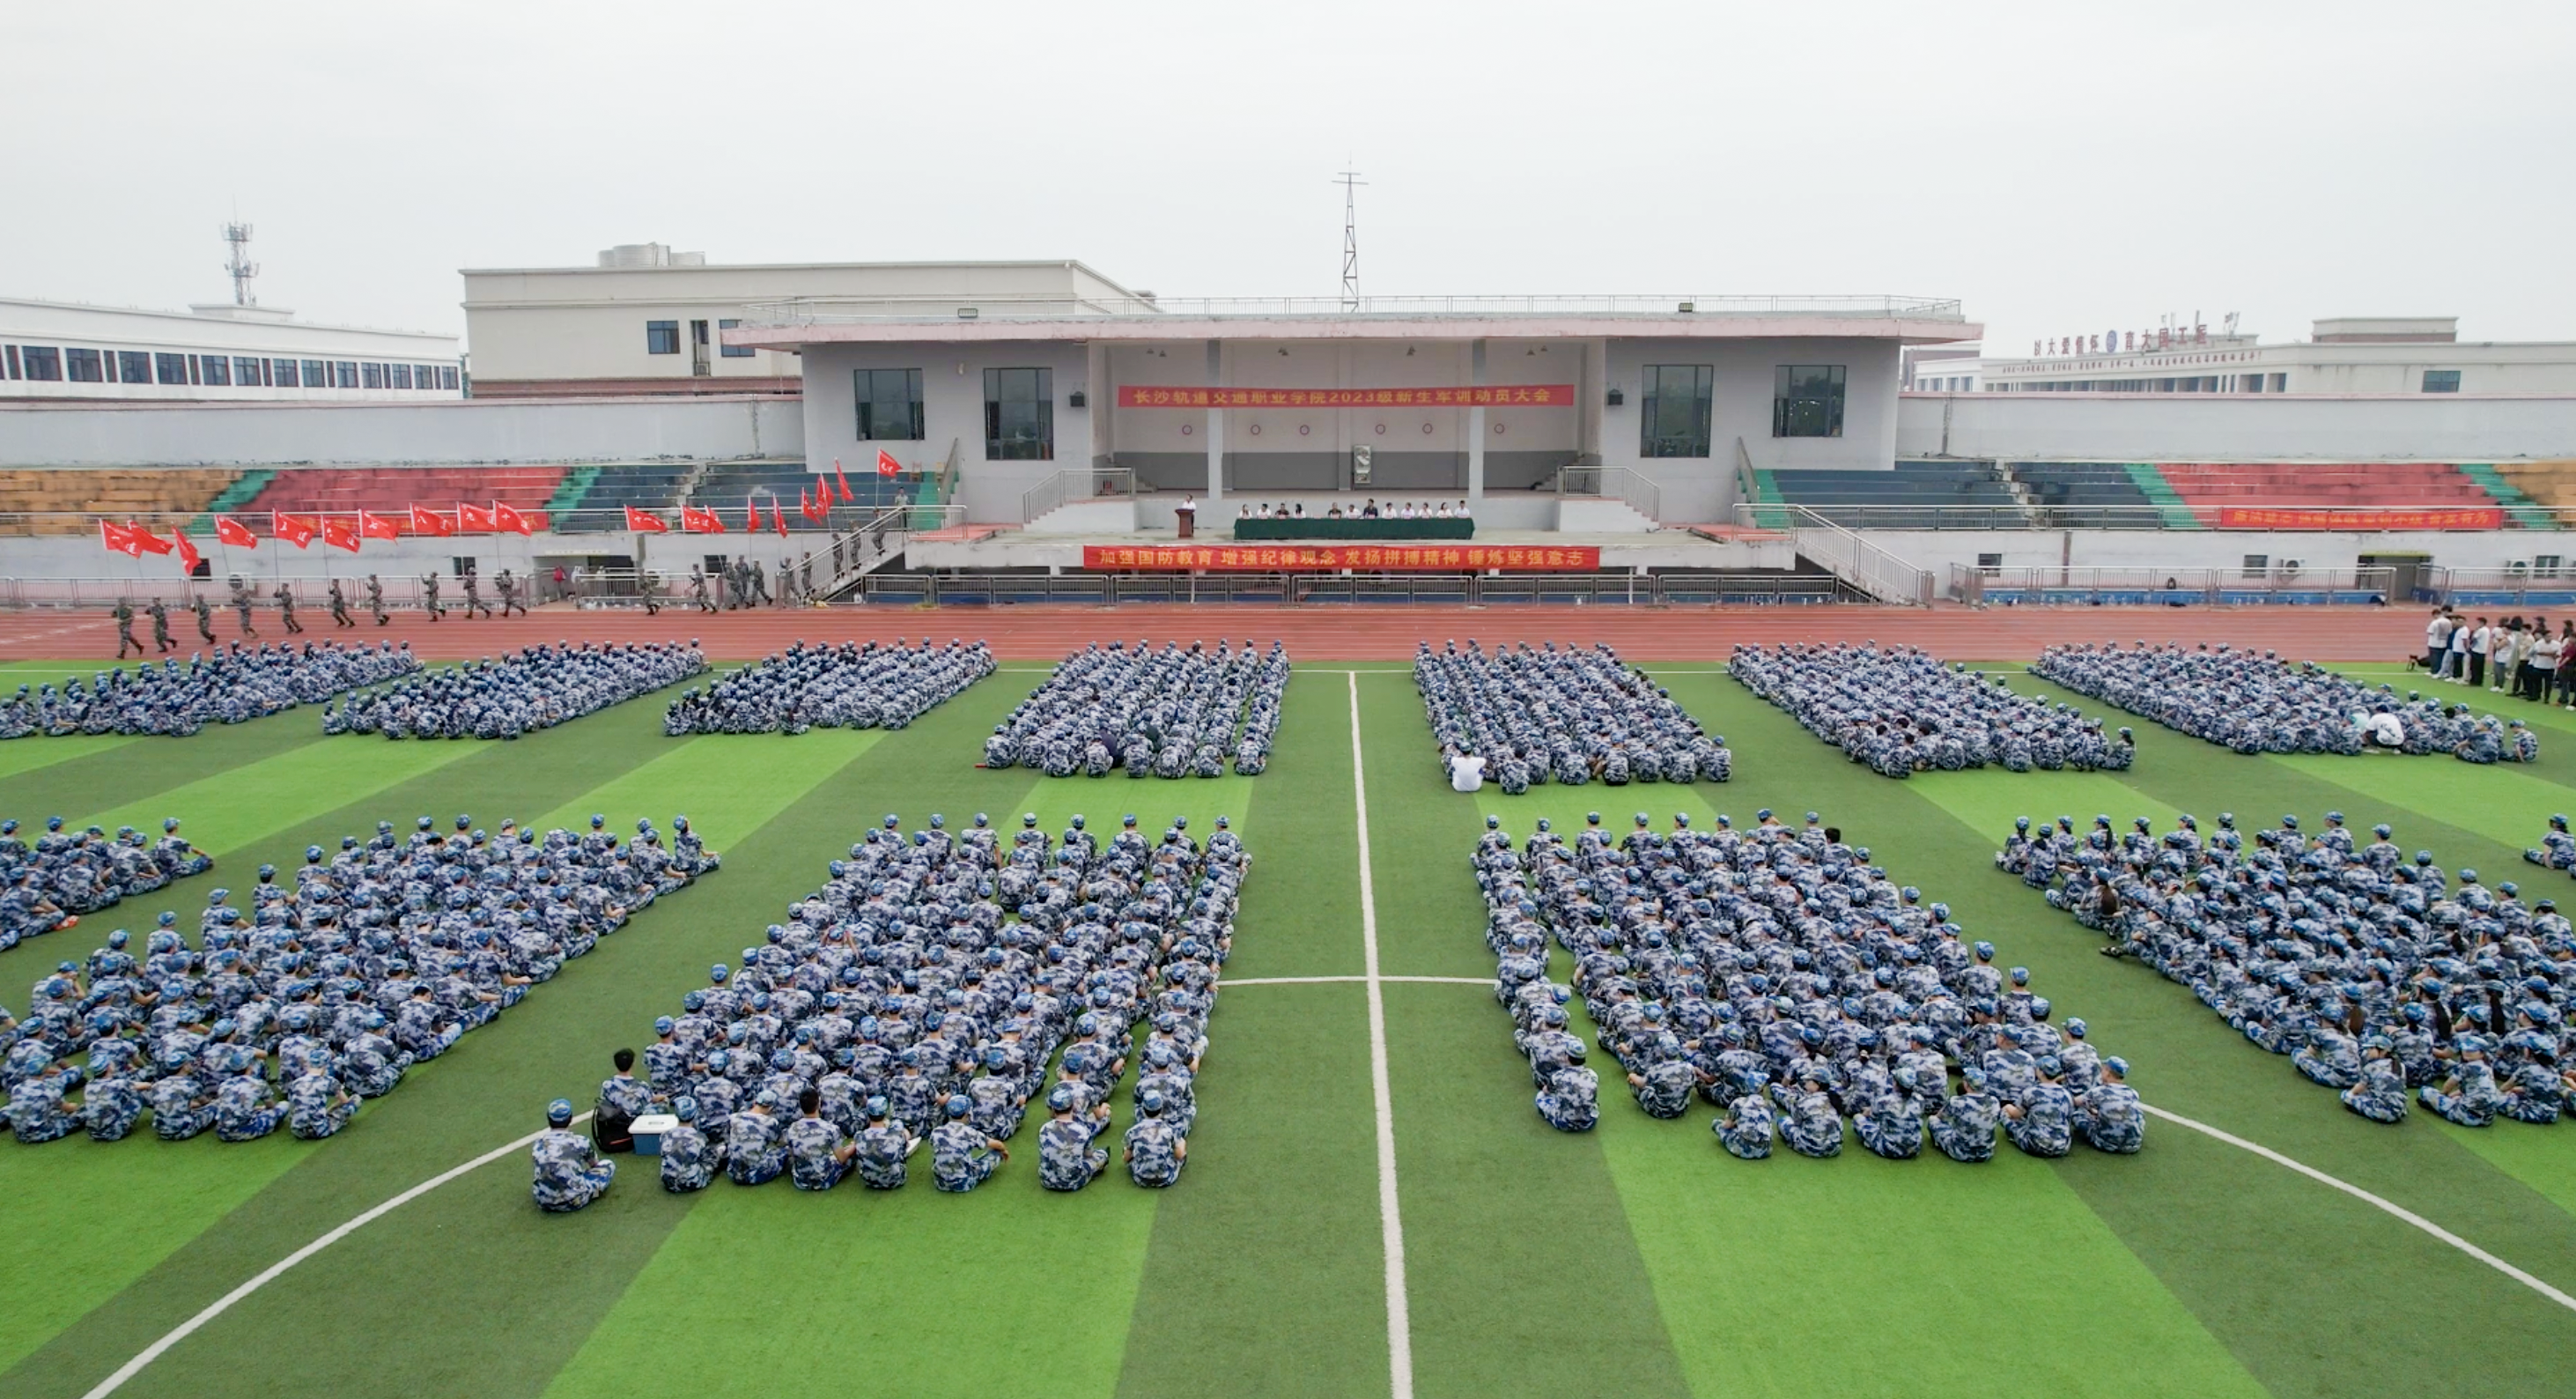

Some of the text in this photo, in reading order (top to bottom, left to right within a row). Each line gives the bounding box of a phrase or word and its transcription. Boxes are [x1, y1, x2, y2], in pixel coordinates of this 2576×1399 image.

[2034, 324, 2208, 357] 以大爱情怀 育大国工匠
[1133, 388, 1551, 405] 长沙轨道交通职业学院2023级新生军训动员大会
[1099, 549, 1584, 566] 加强国防教育 增强纪律观念 发扬拼搏精神 锤炼坚强意志
